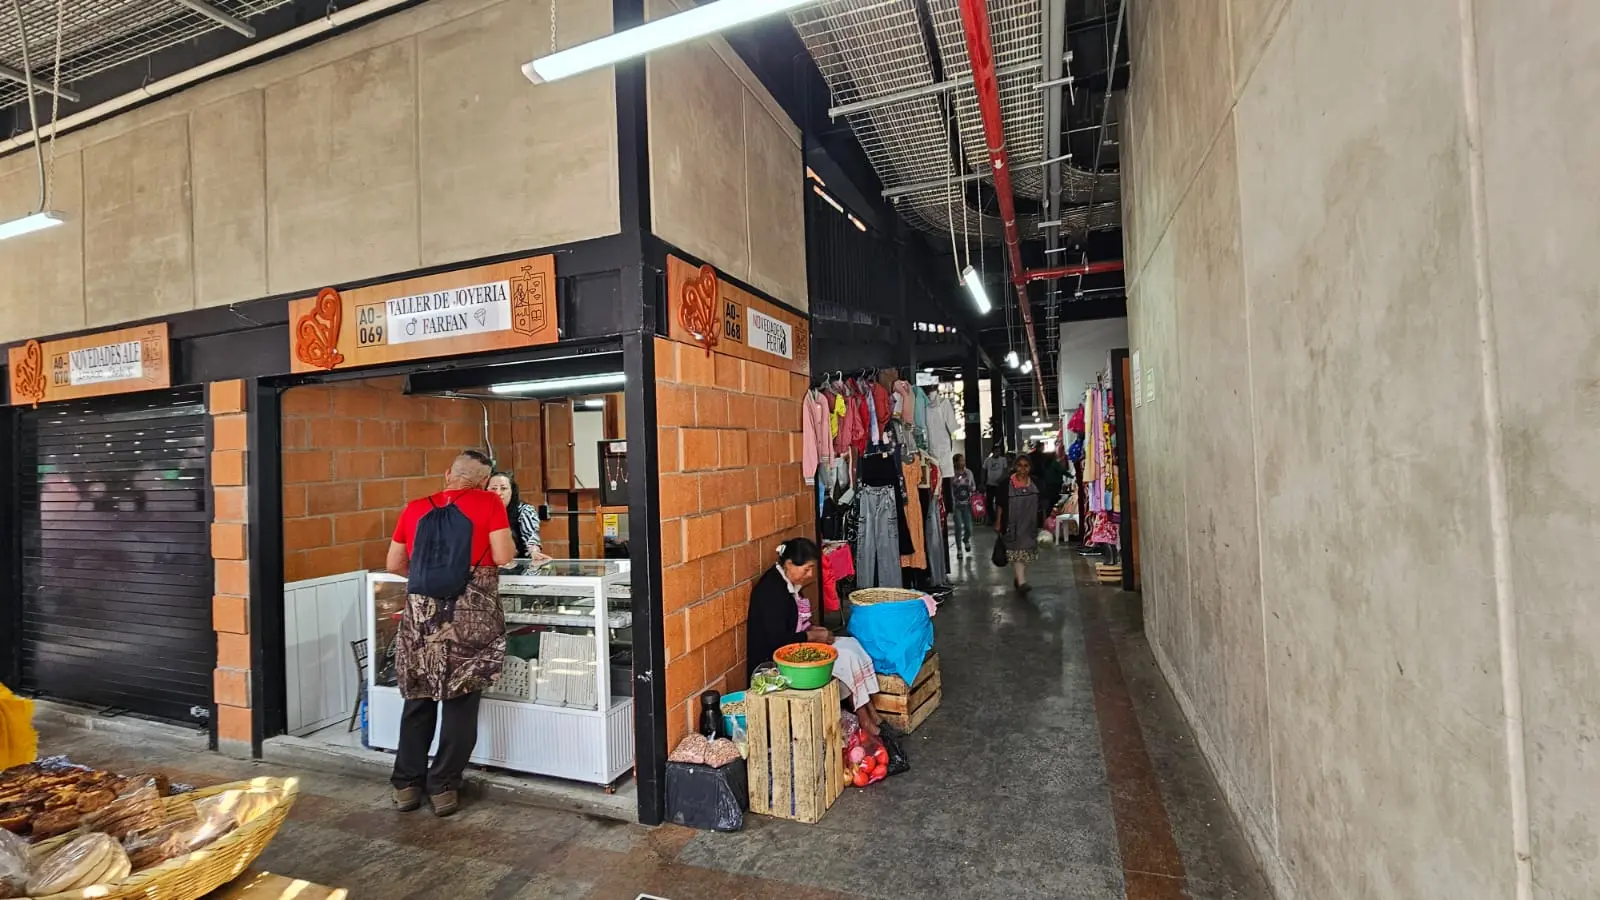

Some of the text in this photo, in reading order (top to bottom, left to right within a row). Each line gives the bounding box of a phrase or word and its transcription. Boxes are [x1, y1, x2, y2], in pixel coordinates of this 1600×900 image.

[388, 284, 507, 316] TALLER DE JOYERIA
[360, 325, 383, 344] 069
[422, 313, 469, 335] FARFAN
[726, 320, 741, 339] 068
[71, 342, 140, 370] NOVEDADES ALE
